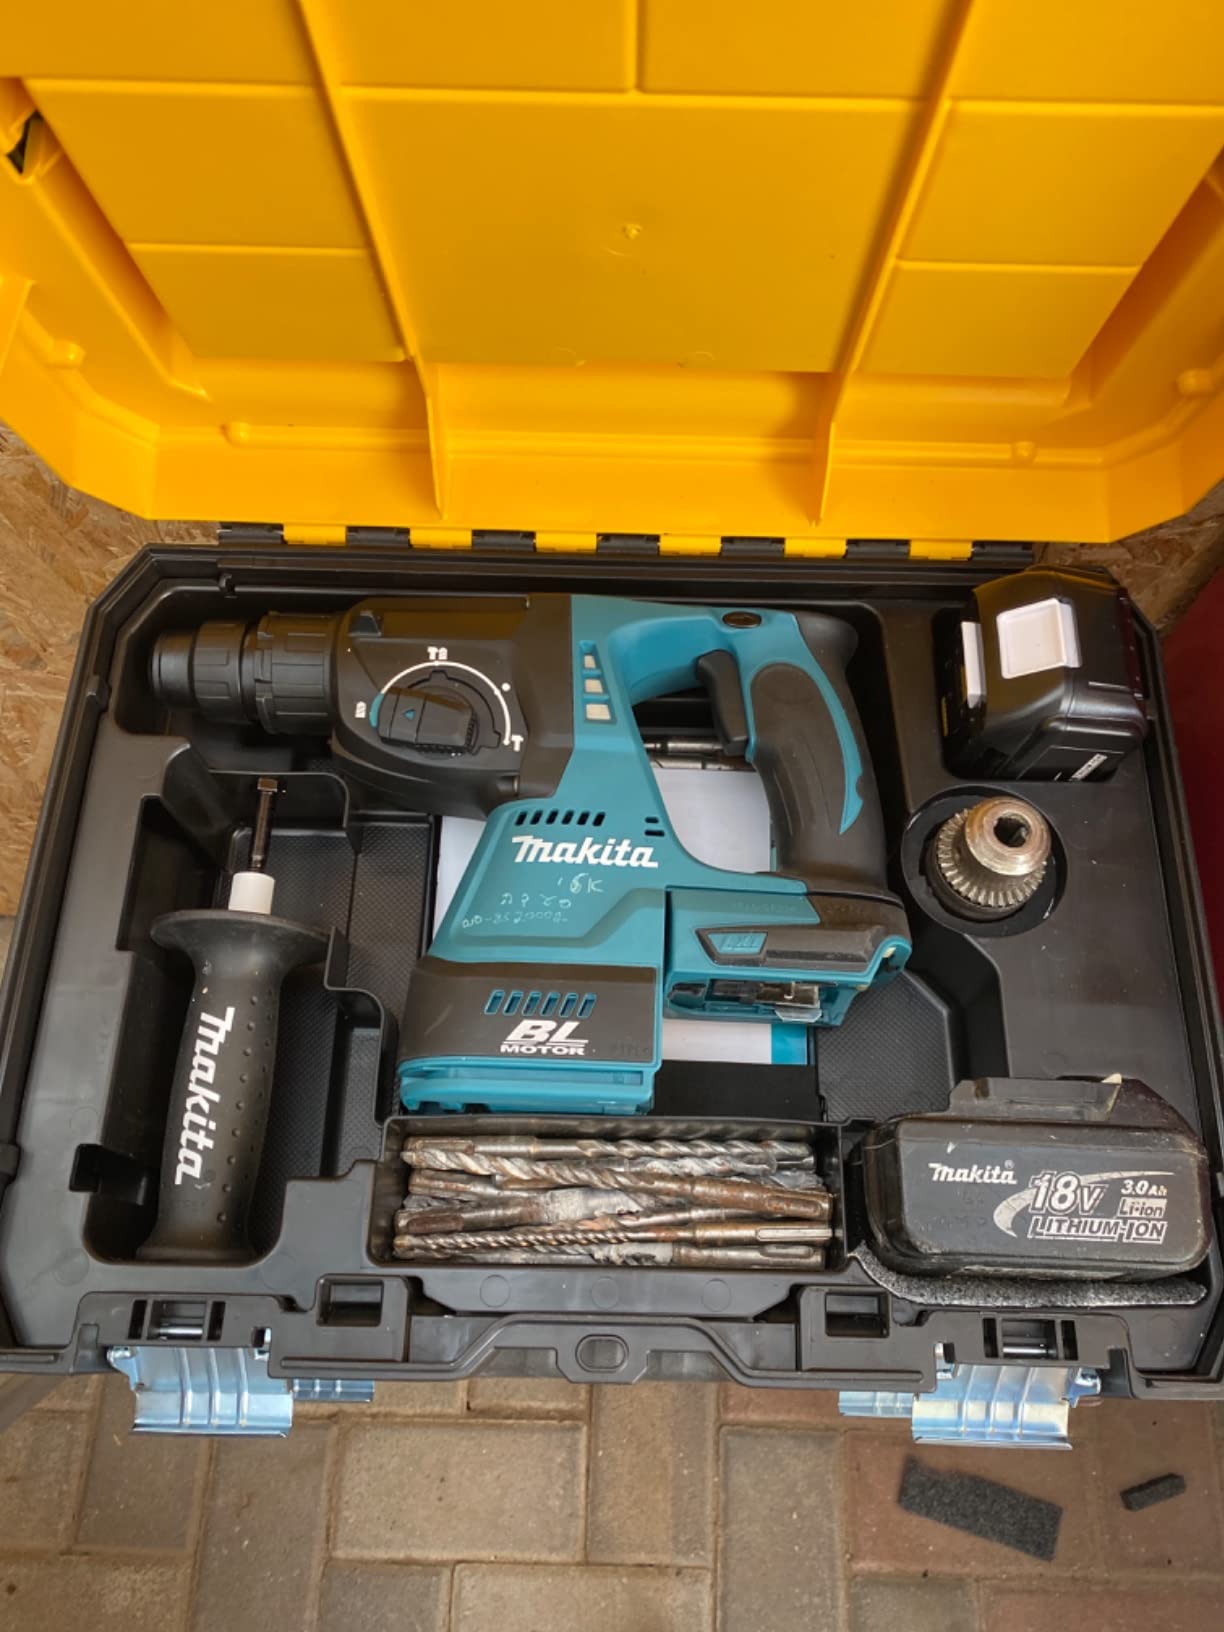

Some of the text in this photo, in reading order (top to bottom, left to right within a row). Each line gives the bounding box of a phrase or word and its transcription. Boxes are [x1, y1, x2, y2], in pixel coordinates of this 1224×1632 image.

[502, 1019, 589, 1047] BL
[500, 1044, 586, 1056] MOTOR
[1028, 1170, 1109, 1215] 18V
